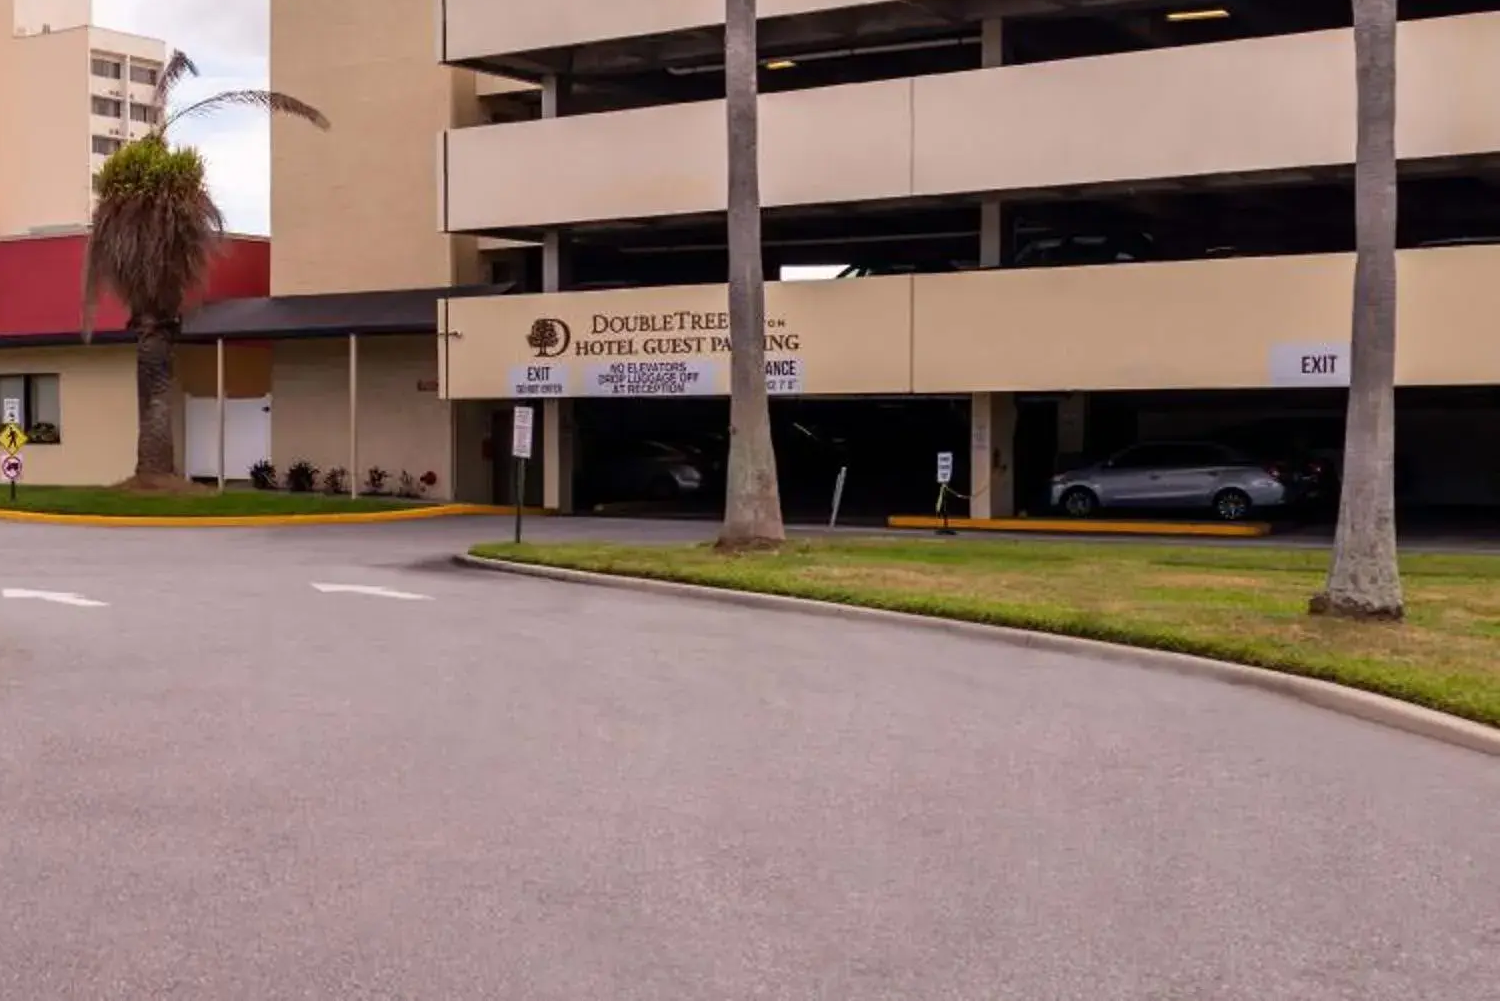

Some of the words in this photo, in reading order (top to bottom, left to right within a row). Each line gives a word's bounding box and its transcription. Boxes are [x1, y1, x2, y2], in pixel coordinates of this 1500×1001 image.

[575, 339, 638, 356] HOTEL
[643, 336, 706, 354] GUEST
[711, 334, 800, 352] PAING
[610, 362, 625, 374] NO
[627, 361, 687, 373] ELEVATORS
[1301, 355, 1338, 374] EXIT
[527, 366, 550, 381] EXIT
[598, 373, 625, 385] DROP
[627, 372, 677, 385] LUGGAGE
[680, 371, 699, 383] OFF
[612, 383, 625, 394] AT
[627, 382, 685, 394] RECEPTION
